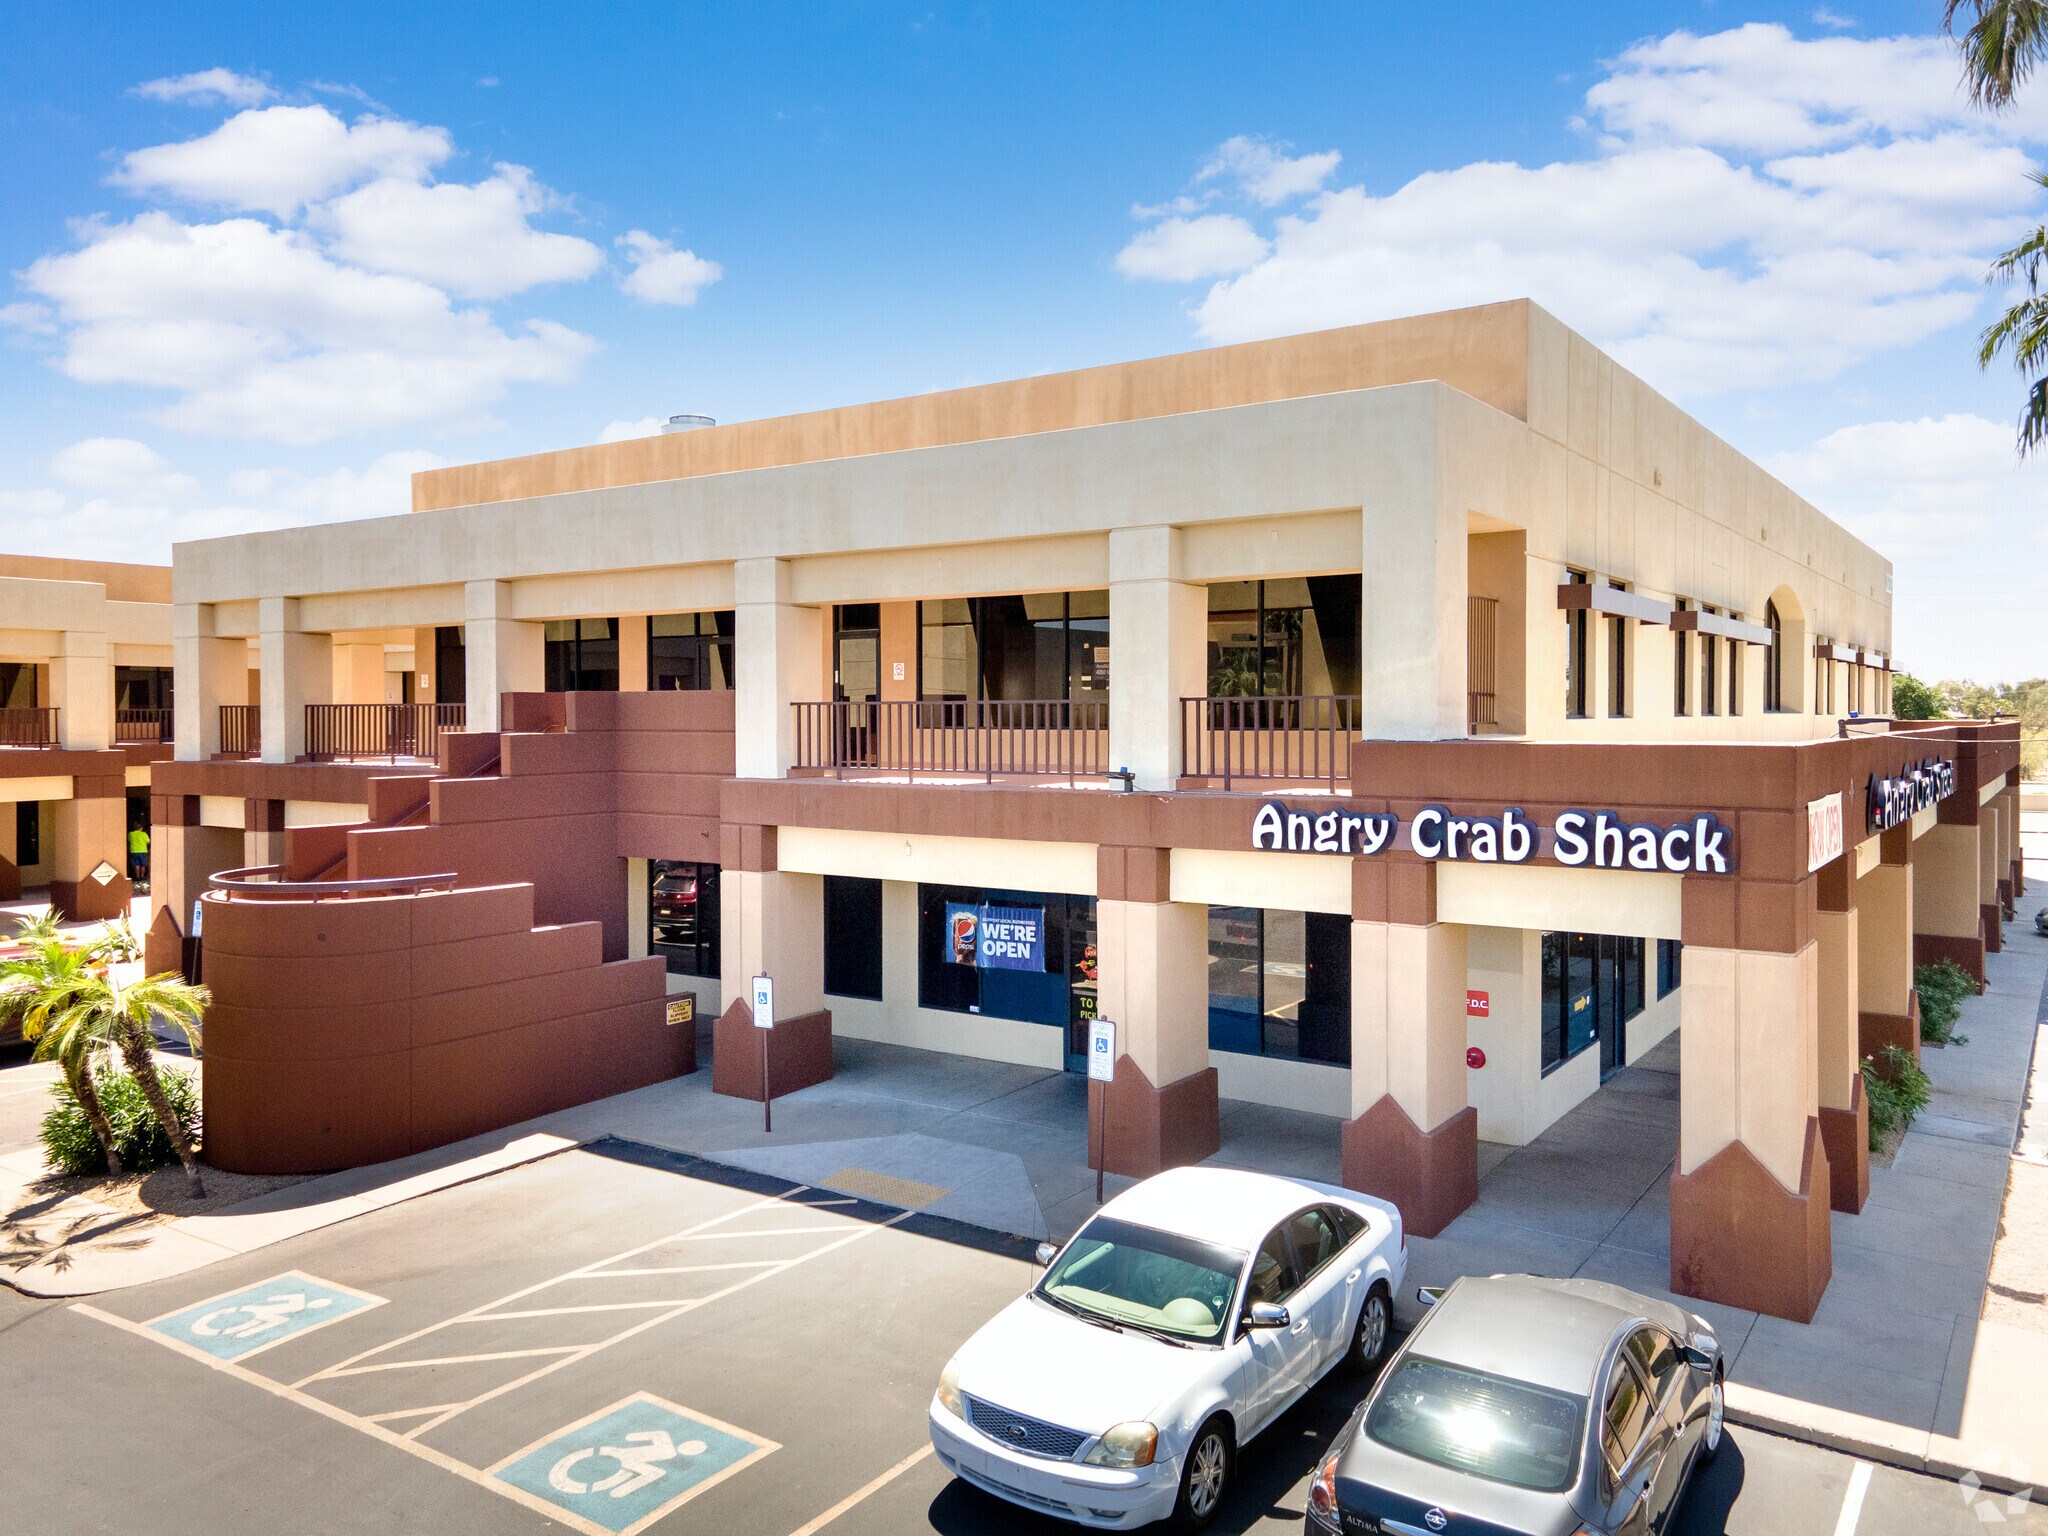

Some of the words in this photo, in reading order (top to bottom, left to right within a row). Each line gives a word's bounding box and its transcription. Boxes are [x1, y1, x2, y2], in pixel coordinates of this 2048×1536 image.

[1252, 803, 1389, 855] Angry
[1411, 809, 1531, 861] Crab
[1554, 812, 1727, 873] Shack
[982, 923, 1036, 942] WE'RE
[957, 943, 975, 951] pepsi
[982, 940, 1031, 959] OPEN
[1080, 997, 1093, 1009] TO
[1346, 1515, 1379, 1535] ALTIMA
